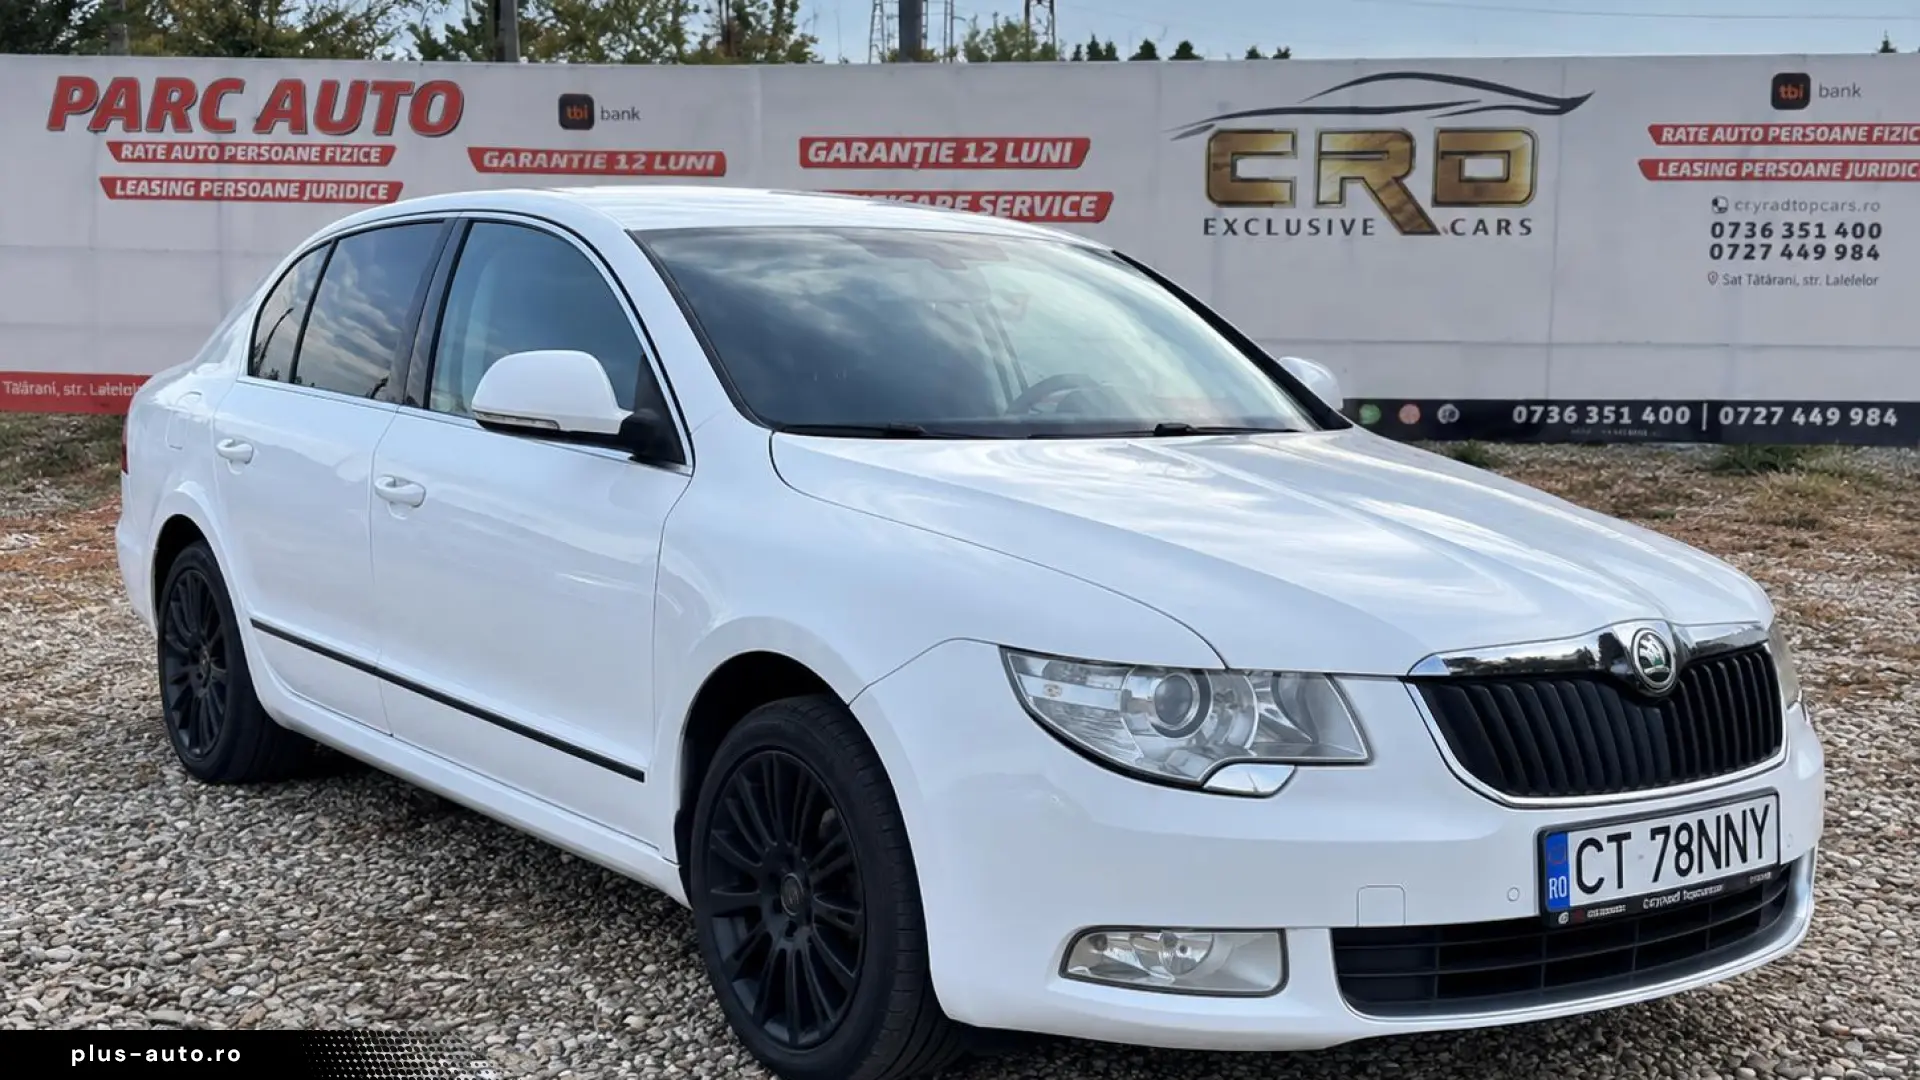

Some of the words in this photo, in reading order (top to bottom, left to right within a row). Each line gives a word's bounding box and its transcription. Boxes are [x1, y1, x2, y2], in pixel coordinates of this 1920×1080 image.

[1778, 84, 1804, 99] tbi
[1819, 82, 1862, 98] bank
[46, 75, 246, 133] PARC
[253, 79, 465, 137] AUTO
[566, 104, 588, 120] tbi
[600, 106, 641, 121] bank
[1661, 126, 1709, 142] RATE
[1713, 126, 1763, 142] AUTO
[1768, 126, 1868, 142] PERSOANE
[121, 144, 166, 160] RATE
[171, 144, 219, 161] AUTO
[224, 145, 320, 162] PERSOANE
[325, 146, 381, 163] FIZICE
[483, 150, 607, 170] GARANTIE
[614, 153, 647, 171] 12
[653, 153, 716, 172] LUNI
[962, 142, 997, 164] 12
[1005, 142, 1073, 164] LUNI
[1658, 162, 1737, 178] LEASING
[1741, 162, 1843, 178] PERSOANE
[1845, 162, 1920, 180] JURIDIC
[116, 179, 195, 197] LEASING
[200, 180, 297, 199] PERSOANE
[303, 181, 389, 201] JURIDICE
[978, 195, 1099, 217] SERVICE
[1735, 198, 1880, 215] cryradtopcars.ro
[1203, 218, 1376, 236] EXCLUSIVE
[1450, 218, 1533, 236] CARS
[1711, 222, 1774, 239] 0736
[1782, 222, 1826, 239] 351
[1835, 222, 1882, 239] 400
[1709, 243, 1772, 261] 0727
[1780, 243, 1826, 261] 449
[1834, 243, 1880, 261] 984
[1723, 273, 1742, 286] Sat
[1803, 275, 1822, 286] str.
[63, 383, 87, 396] str.
[1512, 405, 1578, 424] 0736
[1585, 405, 1632, 424] 351
[1641, 405, 1691, 424] 400
[1718, 406, 1784, 425] 0727
[1791, 406, 1840, 425] 449
[1849, 407, 1898, 426] 984
[1575, 831, 1631, 895] CT
[1548, 875, 1568, 900] RO
